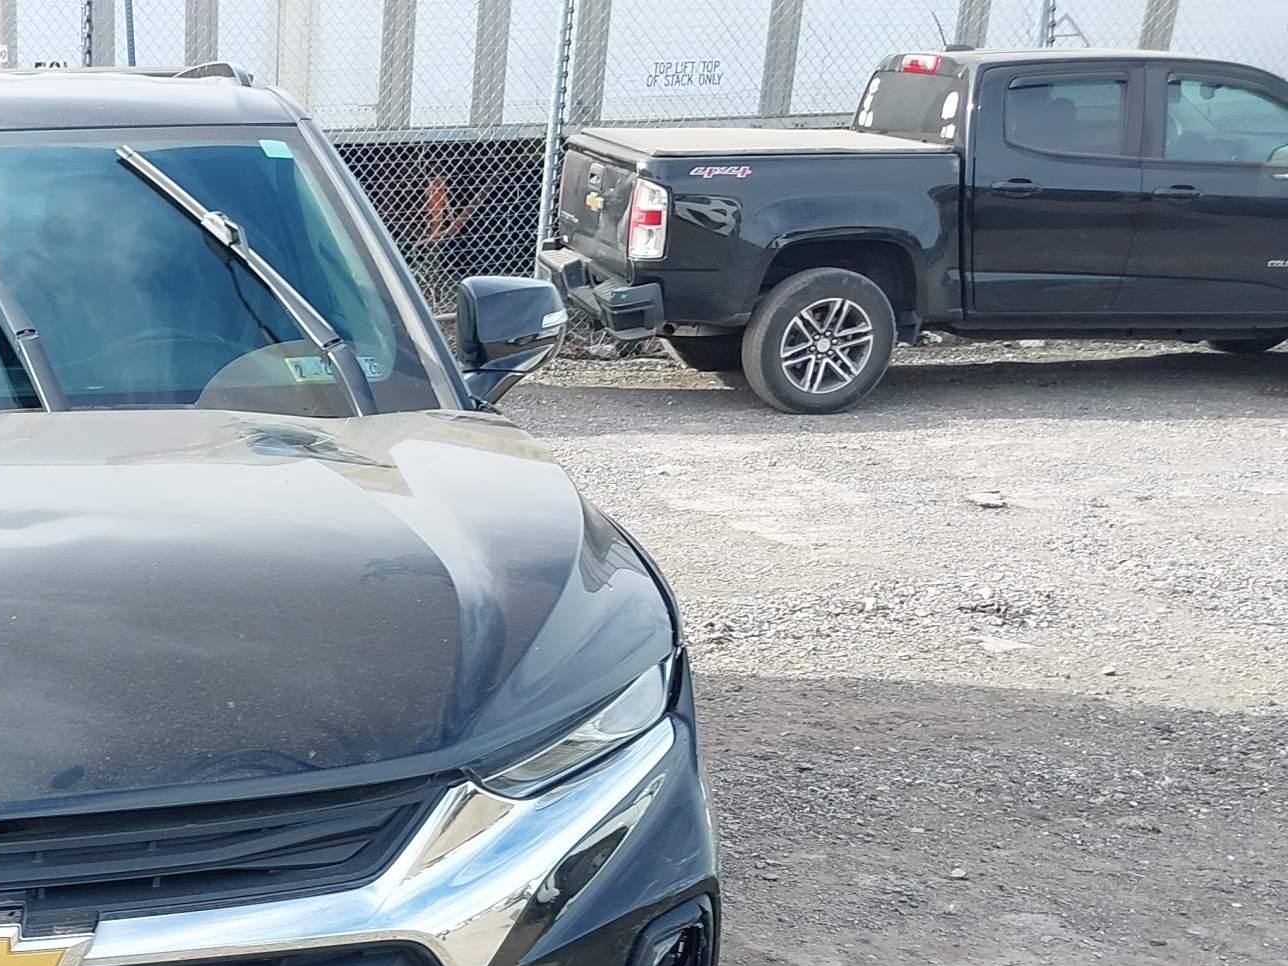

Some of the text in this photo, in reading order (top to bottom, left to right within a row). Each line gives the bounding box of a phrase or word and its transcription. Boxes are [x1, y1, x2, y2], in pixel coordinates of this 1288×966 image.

[654, 62, 672, 74] TOP
[647, 73, 723, 87] OF STACK ONLY
